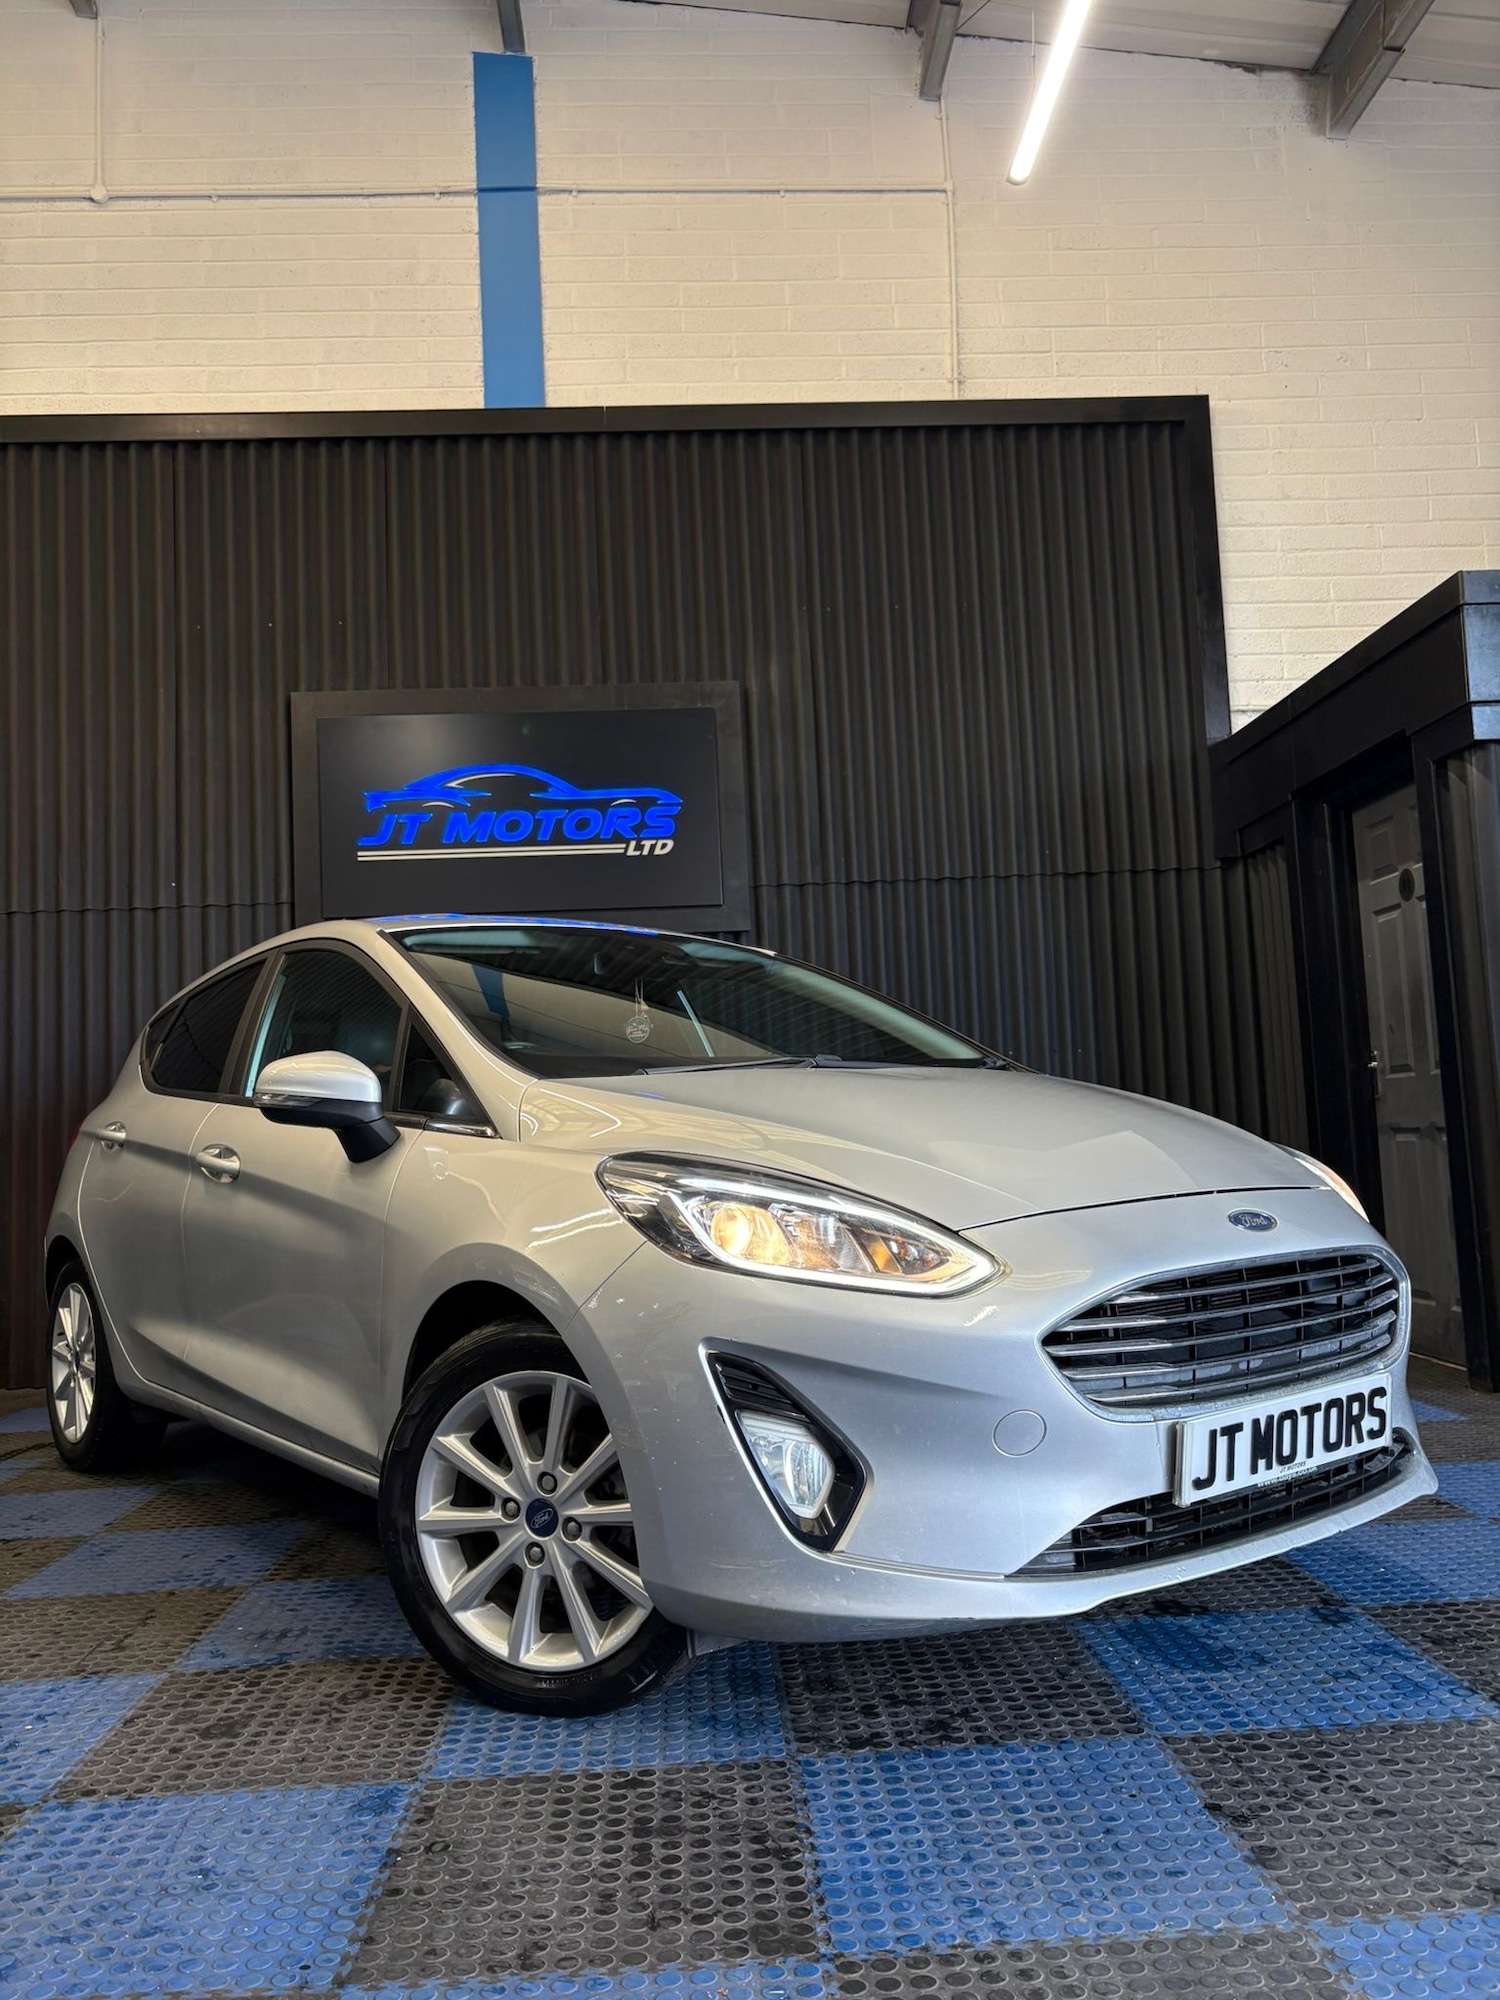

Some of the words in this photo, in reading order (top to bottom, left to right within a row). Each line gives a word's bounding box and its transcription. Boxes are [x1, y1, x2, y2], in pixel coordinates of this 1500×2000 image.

[357, 813, 433, 846] JT
[442, 806, 682, 844] MOTORS
[626, 839, 674, 856] LTD
[1192, 1422, 1244, 1491] JT
[1250, 1387, 1387, 1475] MOTORS
